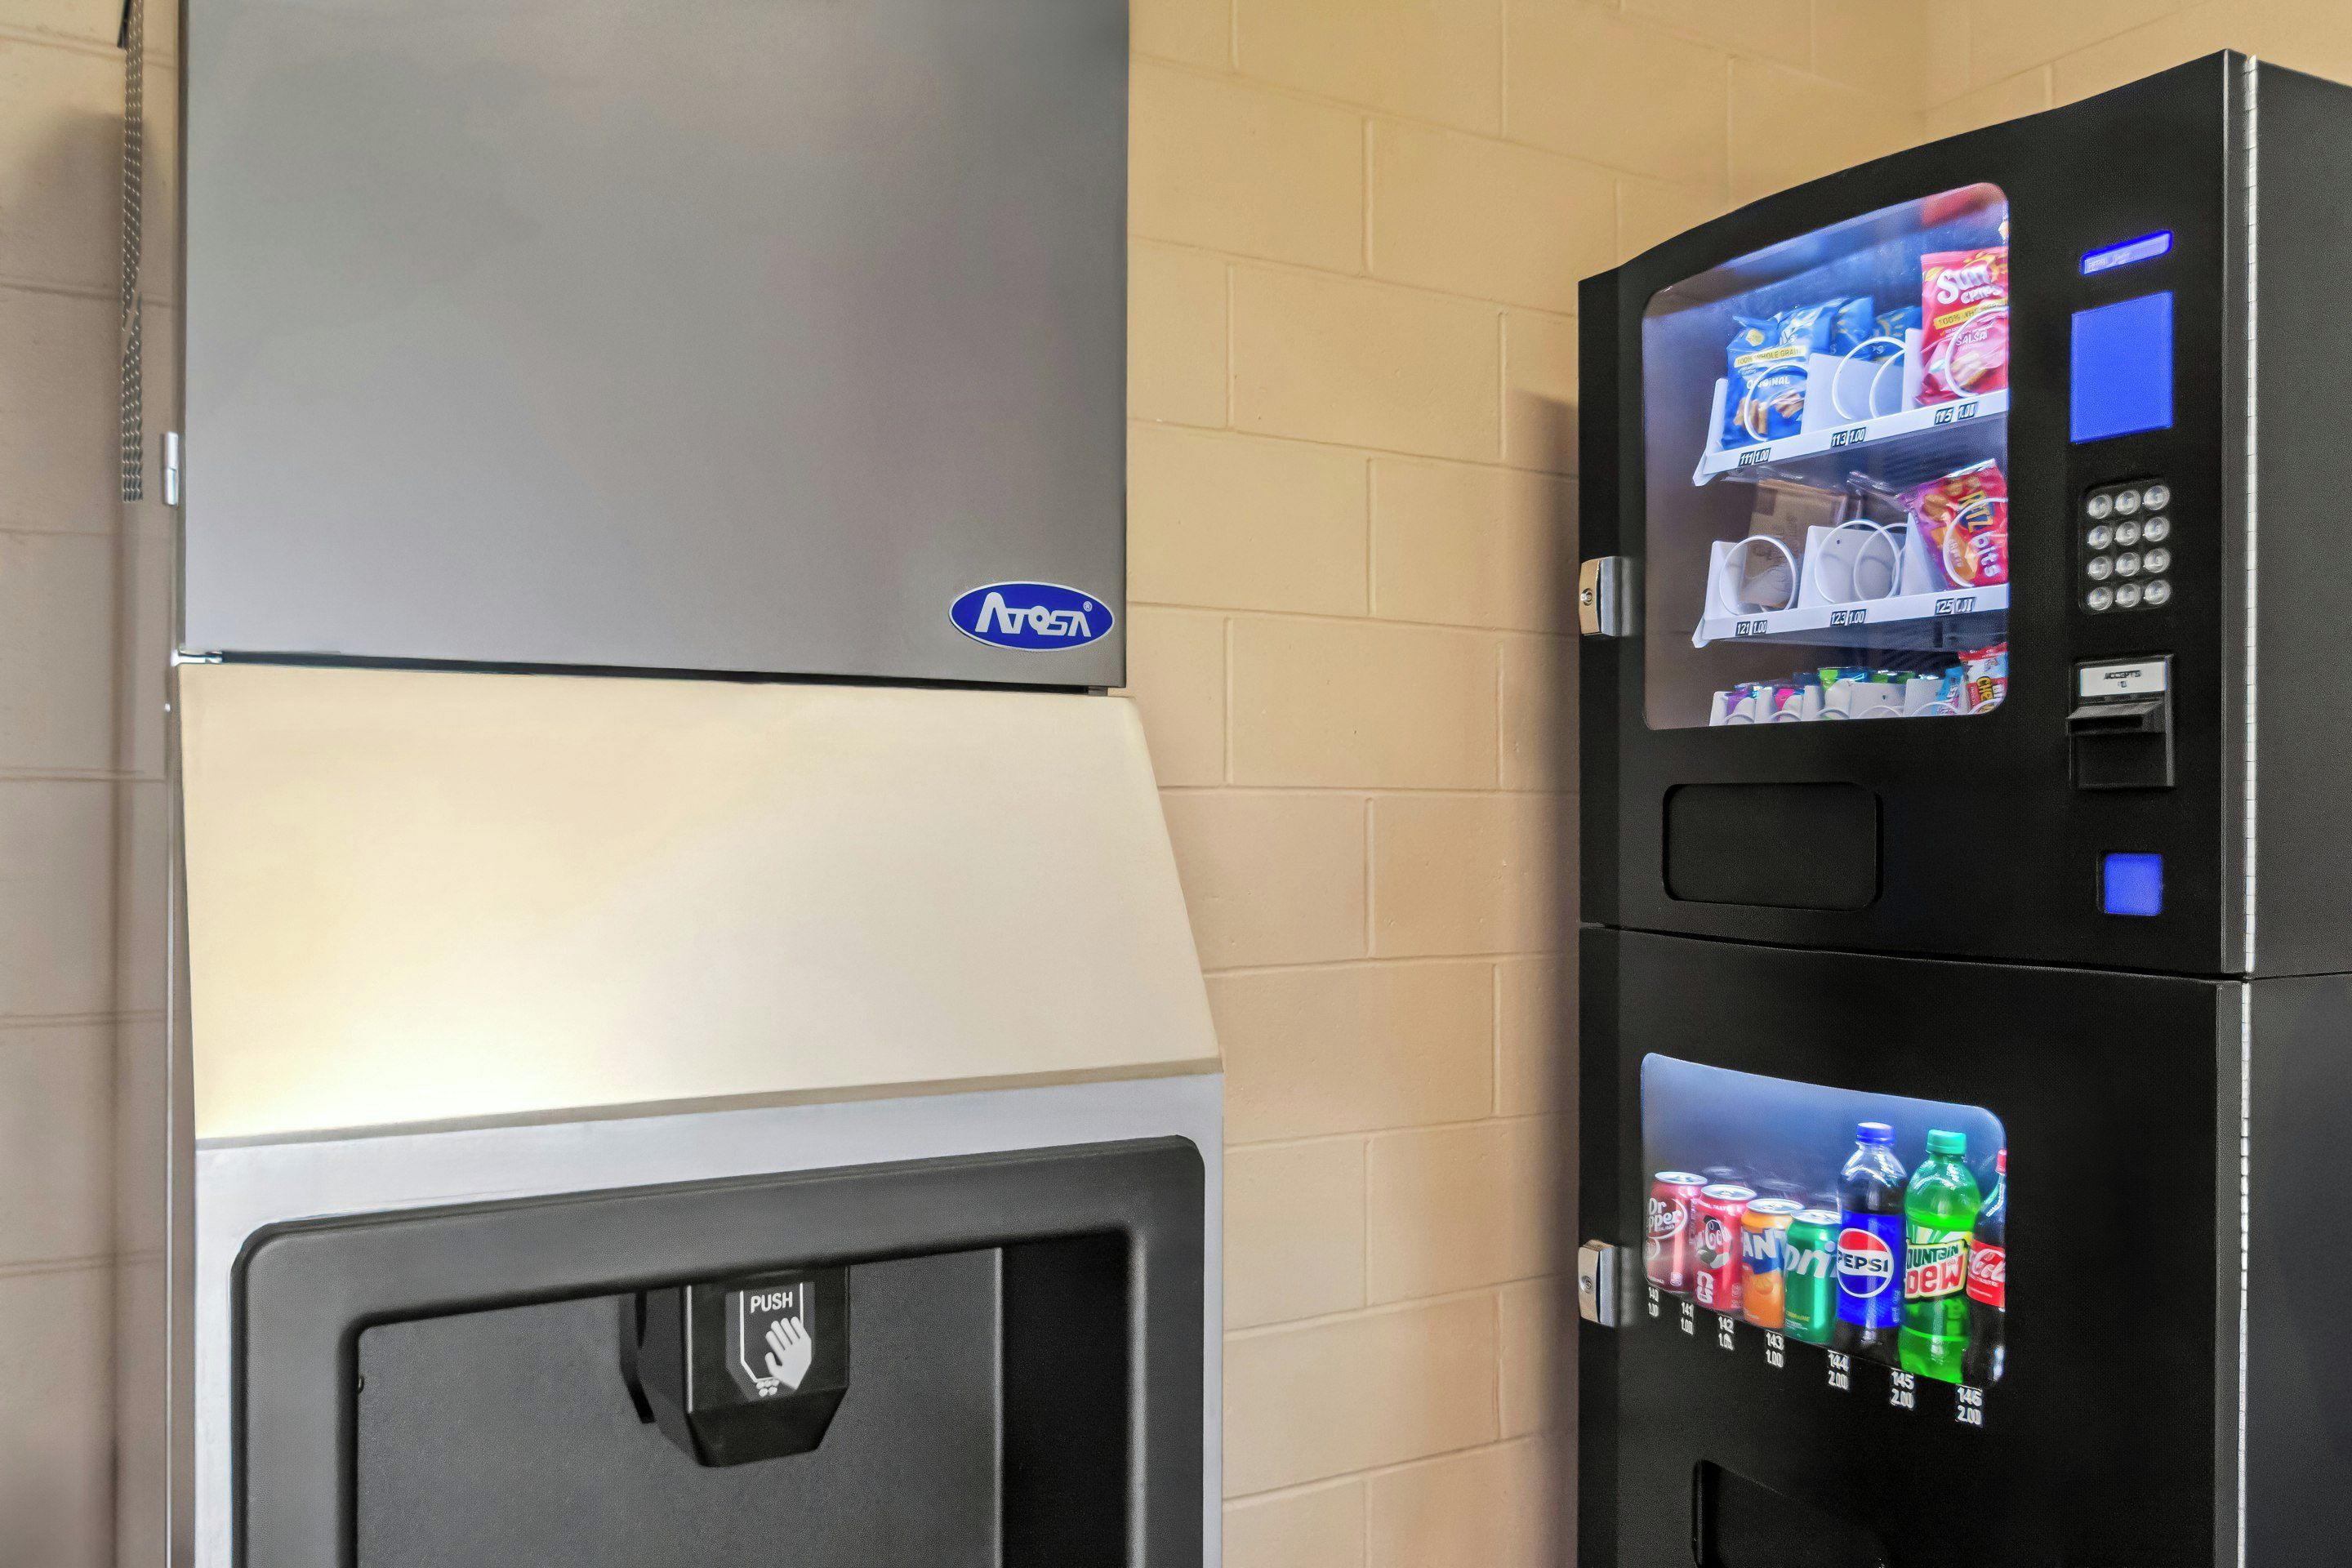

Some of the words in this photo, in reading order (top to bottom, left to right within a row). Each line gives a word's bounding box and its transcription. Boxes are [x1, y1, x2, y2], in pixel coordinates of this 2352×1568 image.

[1936, 264, 1991, 305] Sun
[1955, 331, 1988, 346] SALSA
[1754, 351, 1780, 361] WHOLE
[1832, 433, 1846, 447] 113
[1849, 429, 1865, 443] 1.00
[1740, 452, 1753, 466] 111
[1755, 449, 1770, 462] 1.00
[1737, 622, 1749, 635] 121
[1753, 621, 1767, 634] 1.00
[1832, 612, 1846, 626] 123
[1849, 611, 1865, 624] 1.00
[1648, 1197, 1667, 1215] Dr
[1646, 1209, 1682, 1233] pper
[1741, 1227, 1786, 1260] ANT
[1837, 1249, 1889, 1272] PEPSI
[1907, 1245, 1959, 1270] OUNTAIN
[751, 1291, 793, 1313] PUSH
[1718, 1316, 1734, 1334] 142
[1766, 1332, 1784, 1351] 143
[1766, 1349, 1784, 1368] 1.00
[1829, 1352, 1849, 1372] 144
[1828, 1370, 1849, 1390] 2.00
[1891, 1371, 1914, 1390] 145
[1957, 1388, 1983, 1407] 146
[1957, 1405, 1982, 1425] 2.00
